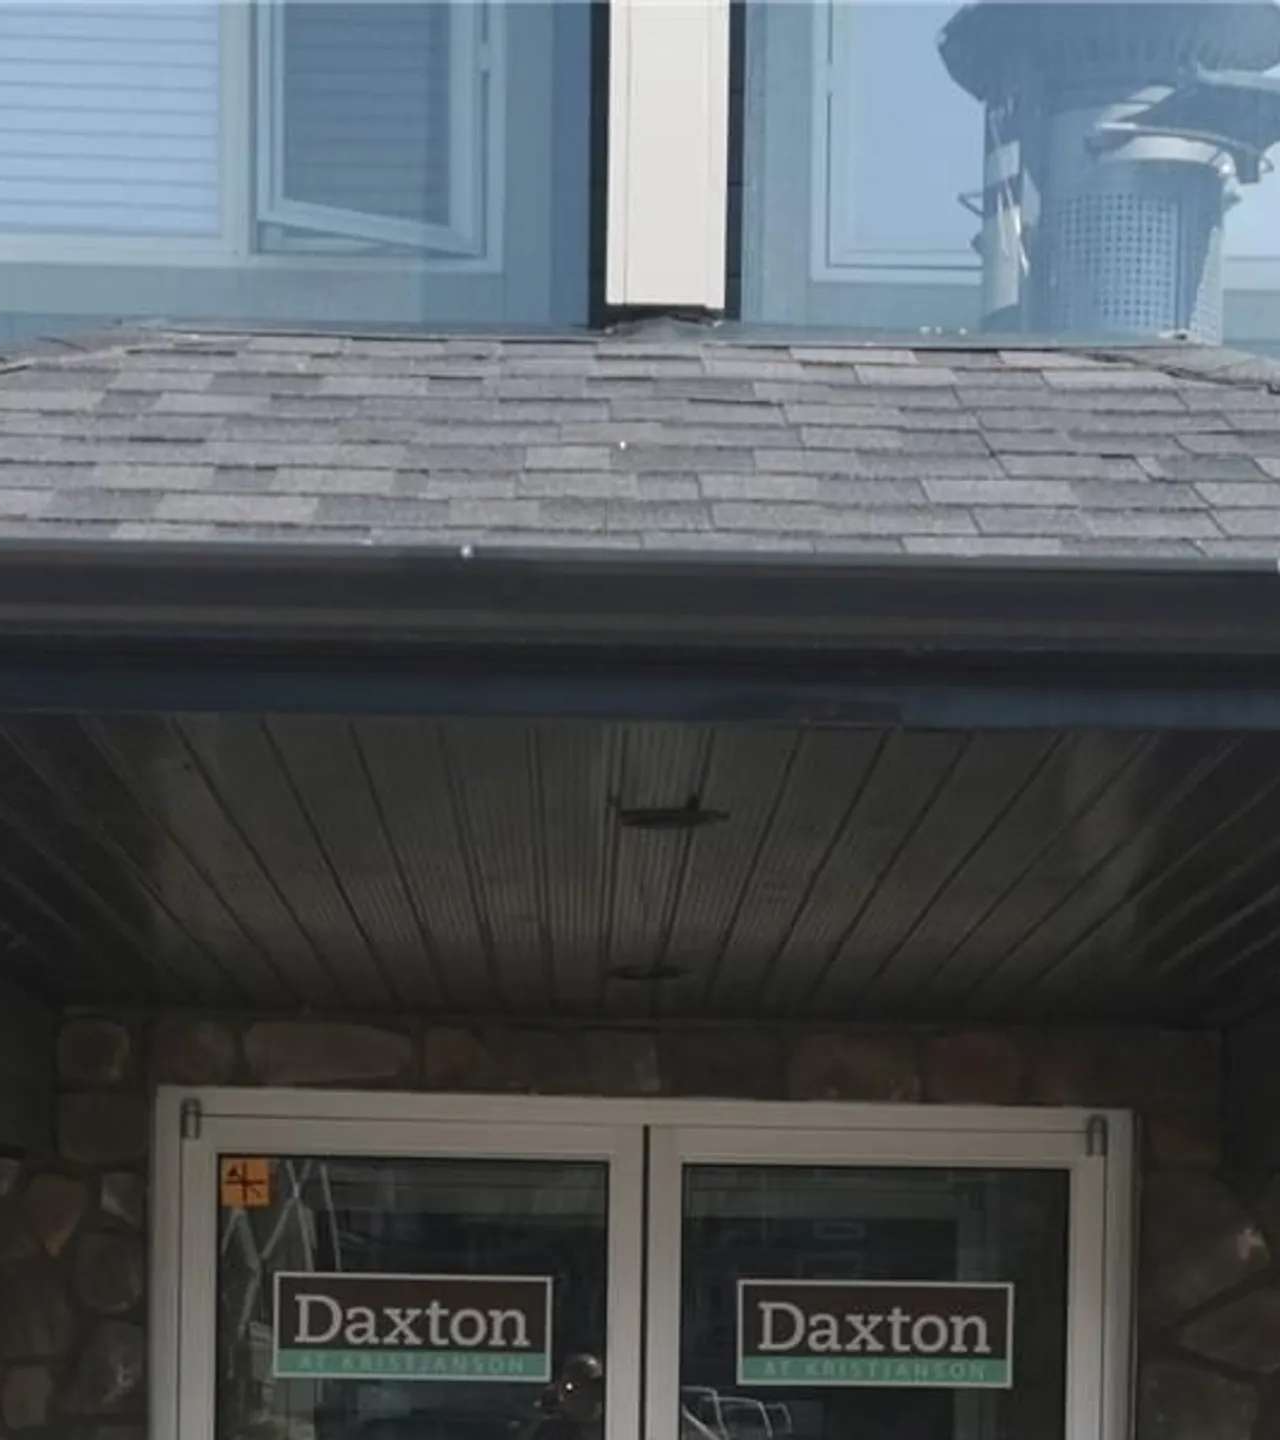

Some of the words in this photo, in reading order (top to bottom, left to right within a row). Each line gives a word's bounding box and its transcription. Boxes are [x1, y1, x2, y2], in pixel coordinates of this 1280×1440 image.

[293, 1292, 532, 1347] Daxton
[757, 1300, 992, 1354] Daxton
[341, 1355, 525, 1374] KRISTJANSON
[763, 1359, 790, 1376] AT
[805, 1360, 987, 1381] KRISTJANSON
